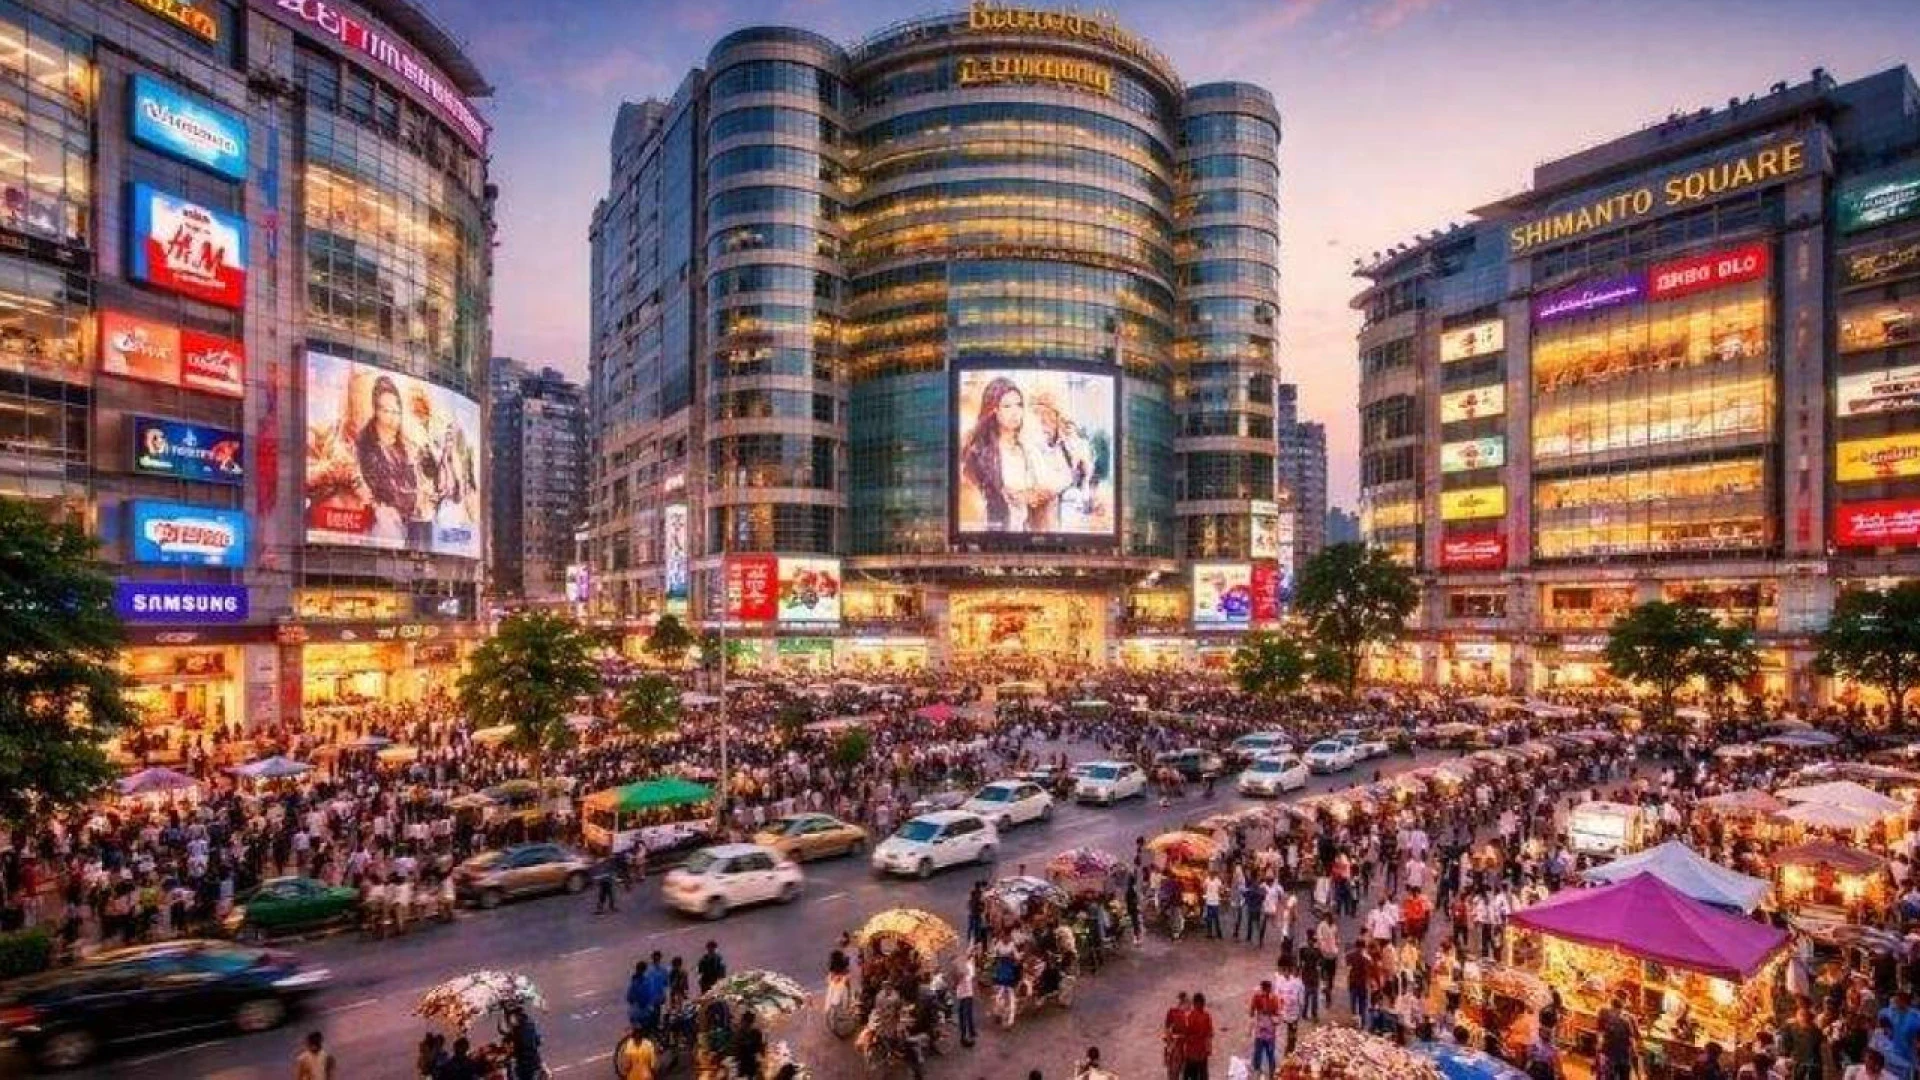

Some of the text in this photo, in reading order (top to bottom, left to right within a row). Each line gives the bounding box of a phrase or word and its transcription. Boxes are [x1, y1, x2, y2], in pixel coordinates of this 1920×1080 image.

[1511, 188, 1653, 252] SHIMANTO
[1665, 141, 1804, 206] SQUARE
[132, 593, 238, 613] SAMSUNG
